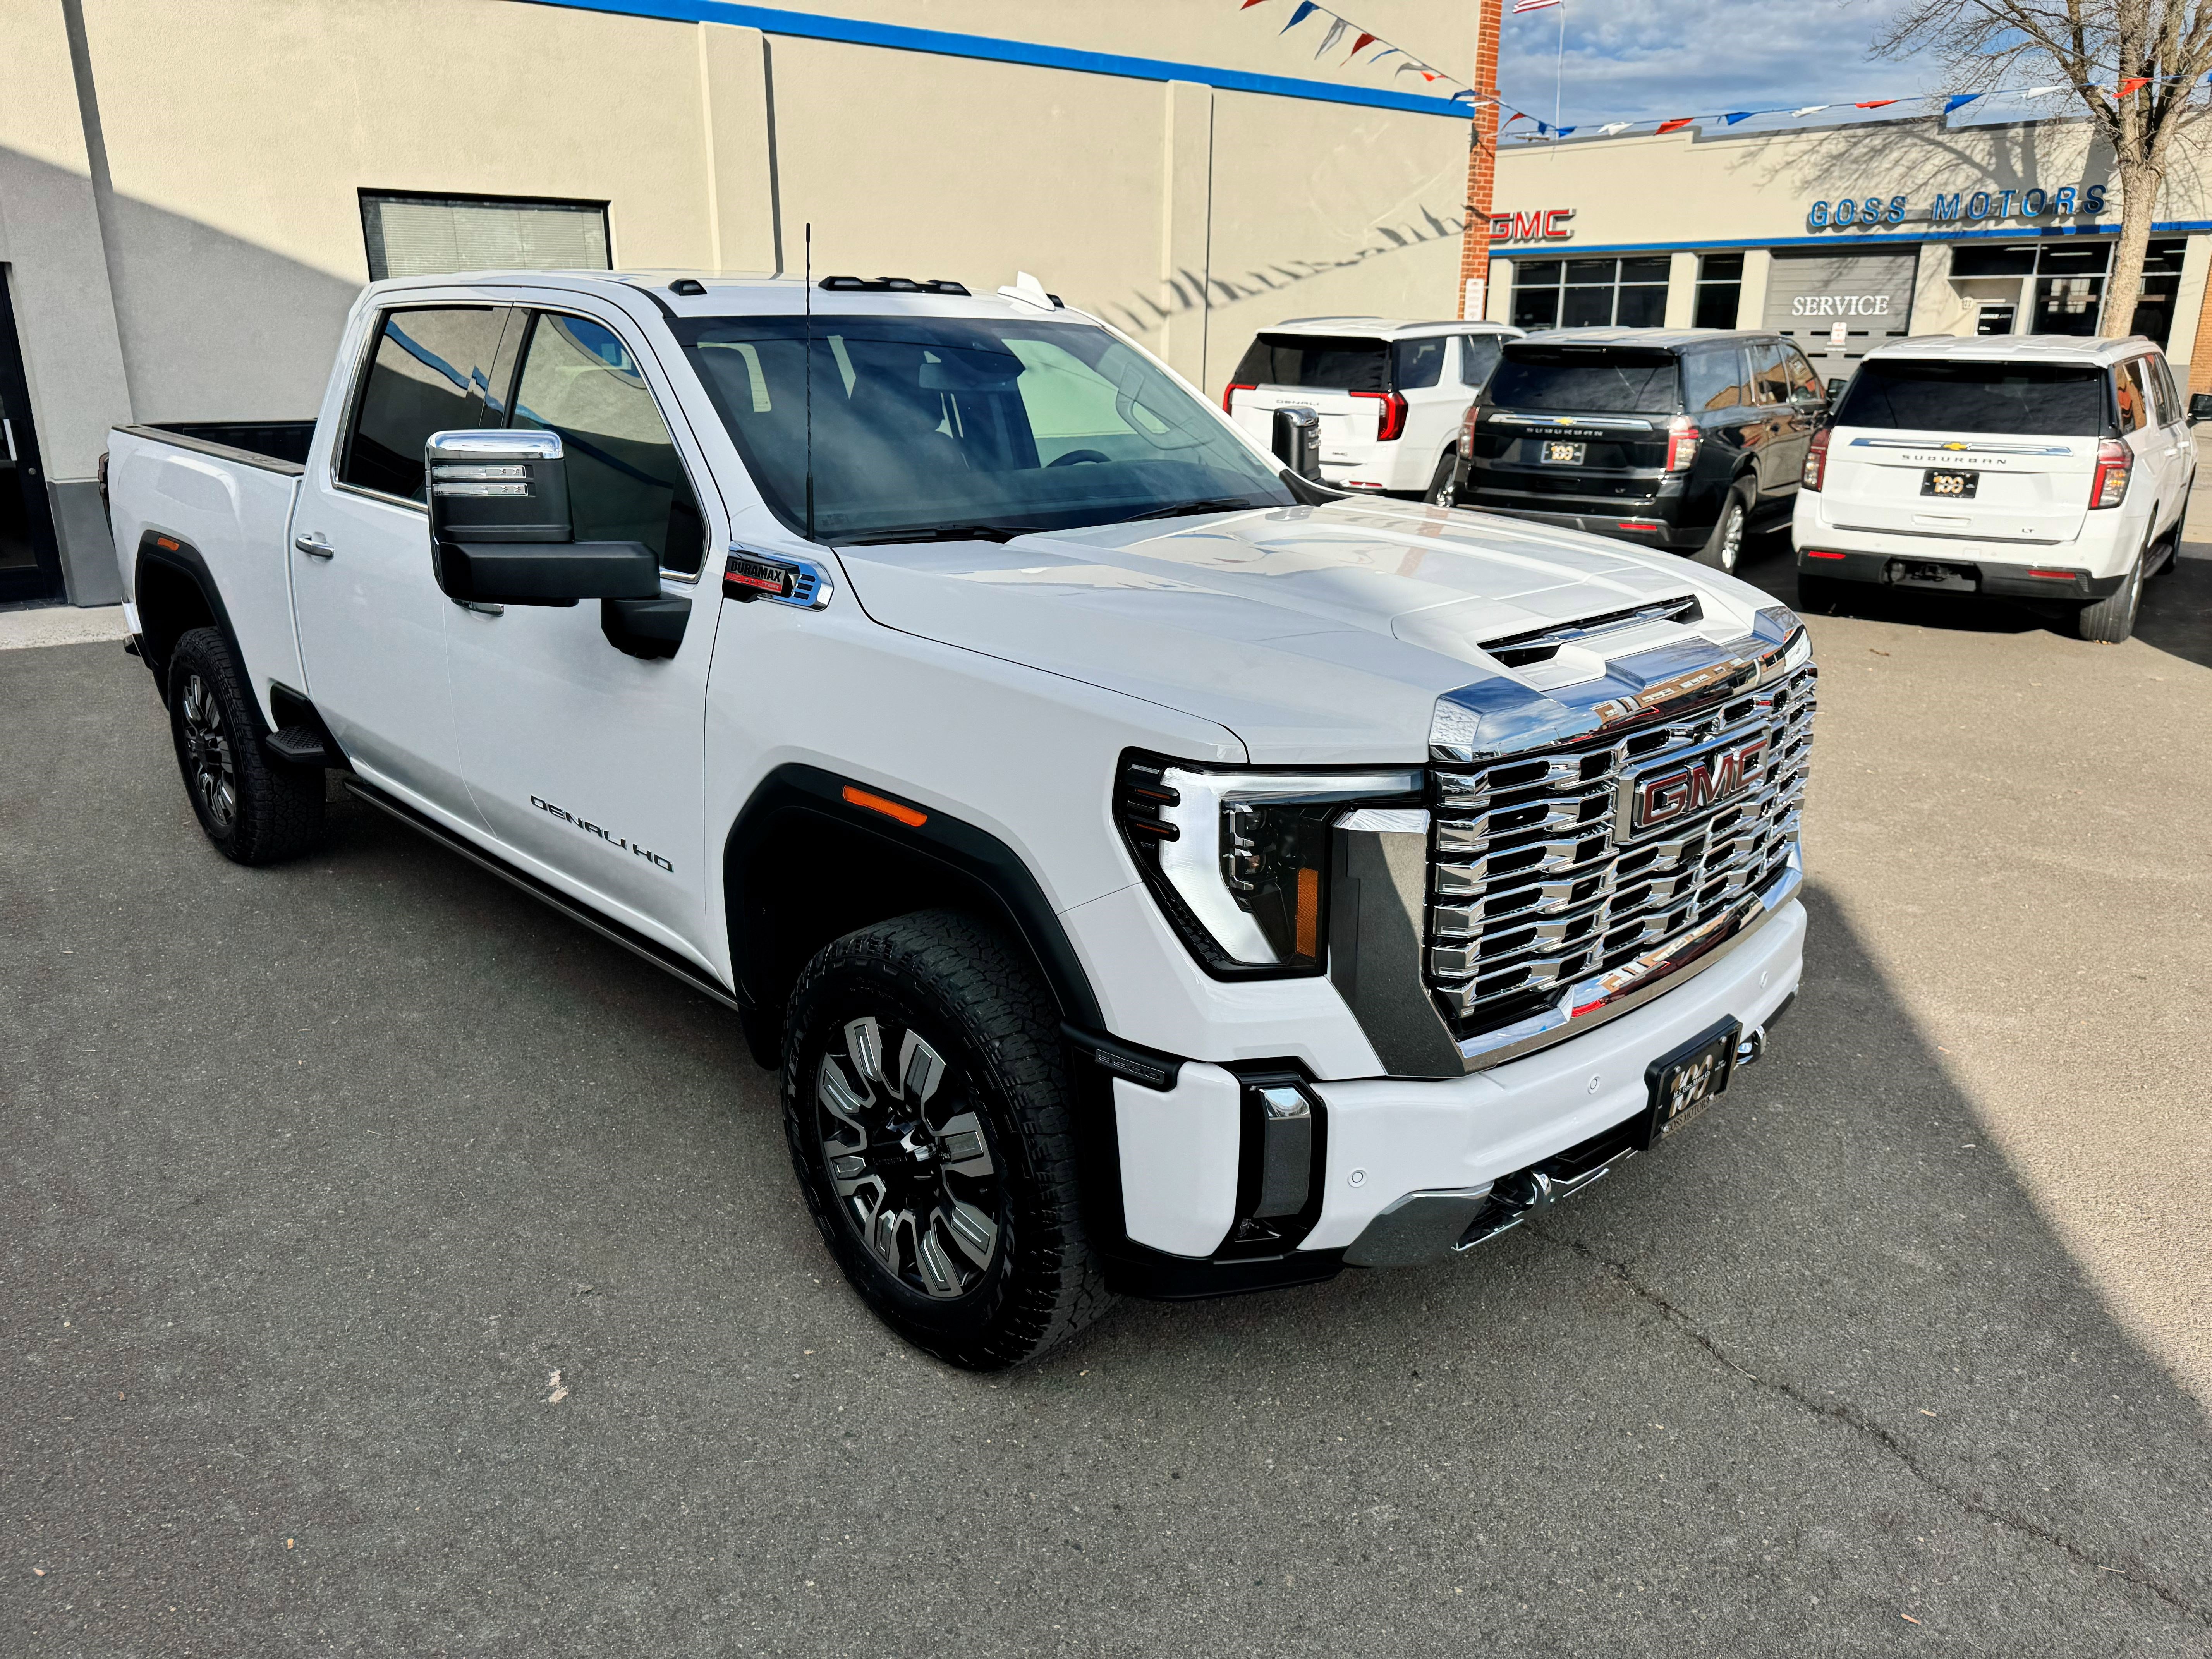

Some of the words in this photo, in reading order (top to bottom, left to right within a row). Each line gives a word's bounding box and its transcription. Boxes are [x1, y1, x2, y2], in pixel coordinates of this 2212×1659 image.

[1808, 196, 1907, 227] GOSS
[1932, 184, 2107, 221] MOTORS
[1490, 208, 1573, 240] GMC
[1791, 295, 1890, 316] SERVICE
[1902, 454, 2007, 464] SUBURBAN
[731, 560, 781, 582] DURAMAX
[1635, 736, 1768, 828] GMC
[530, 793, 627, 850] DENALI
[632, 843, 674, 873] HD
[1098, 1054, 1160, 1080] 2500
[1668, 1054, 1713, 1119] 100
